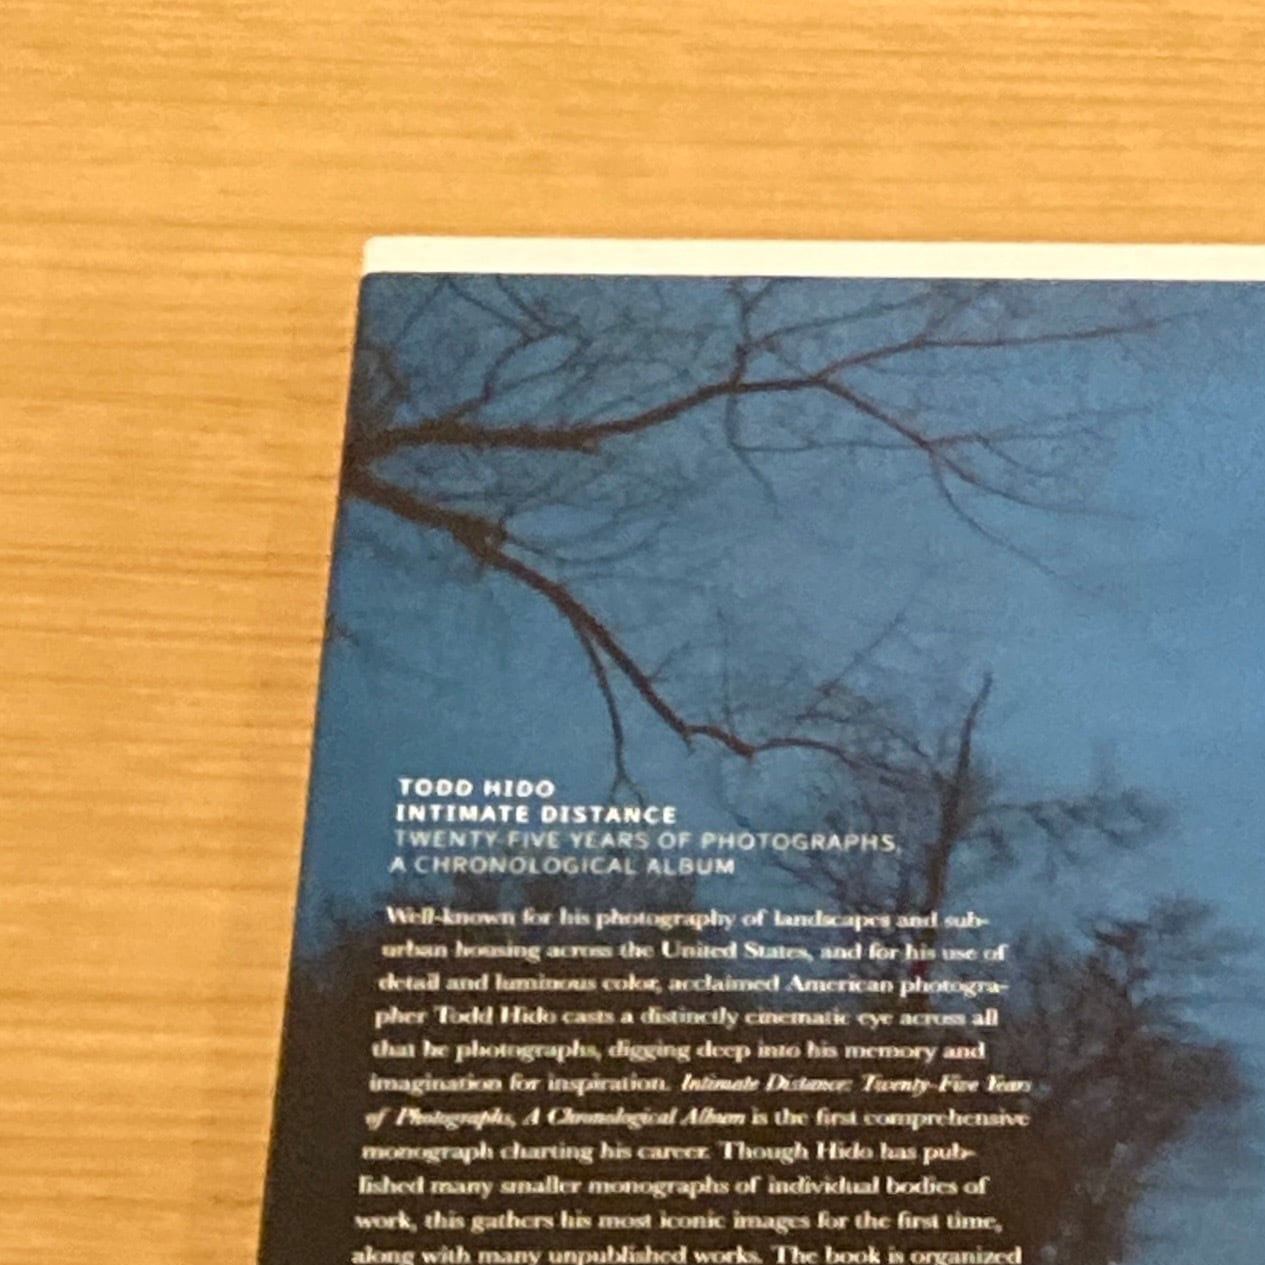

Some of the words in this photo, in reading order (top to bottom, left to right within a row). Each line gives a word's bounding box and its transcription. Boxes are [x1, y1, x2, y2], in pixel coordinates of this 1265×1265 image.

[397, 777, 474, 797] TODD
[482, 779, 556, 799] HIDO
[395, 803, 530, 824] INTIMATE
[540, 804, 677, 825] DISTANCE
[569, 830, 650, 850] YEARS
[657, 829, 692, 851] OF
[388, 856, 407, 873] A
[413, 855, 637, 876] CHRONOLOGICAL
[646, 857, 736, 876] ALBUM
[384, 905, 517, 926] Well-known
[521, 907, 553, 926] for
[559, 906, 592, 926] his
[594, 908, 737, 931] photography
[740, 908, 769, 927] of
[773, 909, 894, 933] landscapes
[895, 911, 939, 929] and
[371, 1038, 416, 1058] that
[421, 1039, 451, 1058] he
[454, 1039, 603, 1064] photographs,
[606, 1039, 692, 1063] digging
[695, 1039, 752, 1064] deep
[756, 1039, 802, 1059] into
[805, 1040, 839, 1059] his
[844, 1045, 939, 1064] memory
[941, 1040, 987, 1060] and
[368, 1072, 504, 1096] imagination
[508, 1072, 542, 1092] for
[750, 1107, 769, 1126] is
[773, 1107, 810, 1126] the
[815, 1106, 860, 1126] first
[862, 1108, 1031, 1131] comprehensive
[360, 1141, 495, 1165] monograph
[498, 1141, 595, 1165] charting
[598, 1140, 633, 1160] his
[716, 1140, 810, 1165] Though
[815, 1140, 875, 1160] Hido
[879, 1141, 919, 1161] has
[358, 1174, 426, 1195] lished
[429, 1180, 494, 1200] many
[499, 1175, 583, 1195] smaller
[587, 1175, 731, 1200] monographs
[733, 1175, 763, 1194] of
[767, 1175, 881, 1195] individual
[885, 1175, 959, 1195] bodies
[961, 1175, 991, 1195] of
[353, 1209, 418, 1232] work,
[423, 1210, 466, 1230] this
[469, 1209, 555, 1234] gathers
[559, 1209, 593, 1229] his
[597, 1213, 653, 1229] most
[658, 1210, 726, 1229] iconic
[732, 1210, 812, 1235] images
[816, 1210, 851, 1230] for
[853, 1209, 892, 1230] the
[896, 1210, 941, 1230] first
[945, 1211, 1004, 1233] time,
[420, 1245, 473, 1265] with
[769, 1244, 820, 1265] The
[824, 1245, 882, 1265] book
[886, 1245, 906, 1265] is
